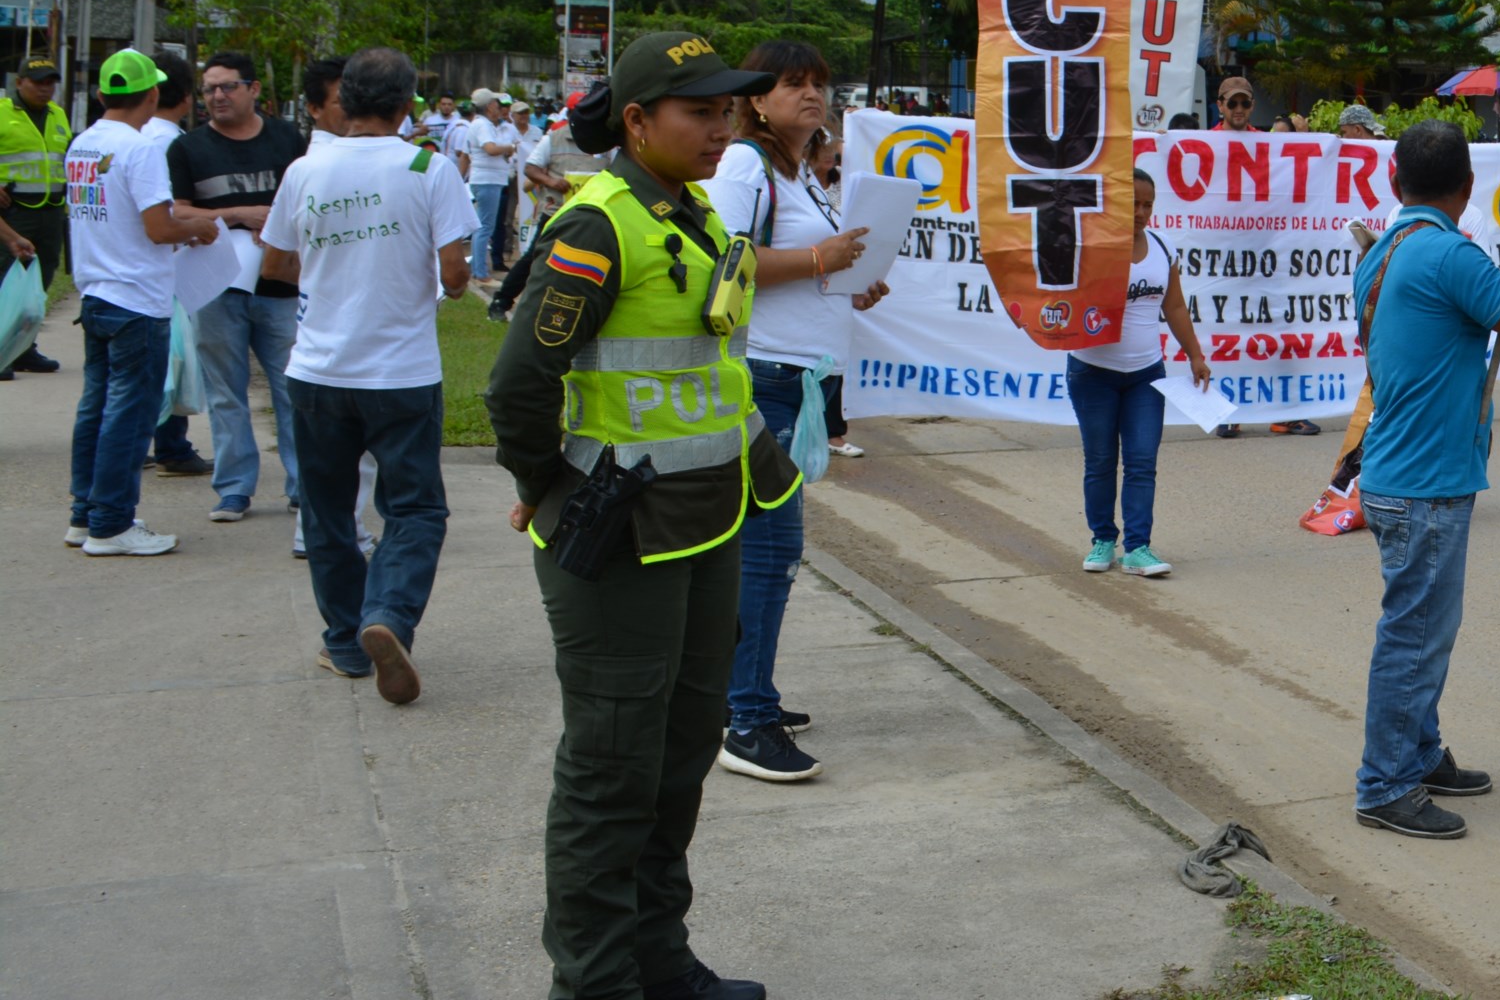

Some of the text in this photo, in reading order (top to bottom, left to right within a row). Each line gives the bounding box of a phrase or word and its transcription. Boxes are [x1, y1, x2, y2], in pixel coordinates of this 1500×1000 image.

[1133, 138, 1403, 211] ONTR
[306, 190, 382, 218] Respira
[305, 221, 401, 251] Amazonas
[1166, 215, 1182, 229] DE
[1188, 214, 1287, 231] TRABAJADORES
[1291, 216, 1308, 230] DE
[1312, 216, 1327, 230] LA
[1289, 248, 1357, 278] SOCI
[957, 281, 994, 313] LA
[1212, 295, 1229, 323] Y
[1240, 295, 1273, 324] LA
[1284, 294, 1358, 323] JUST
